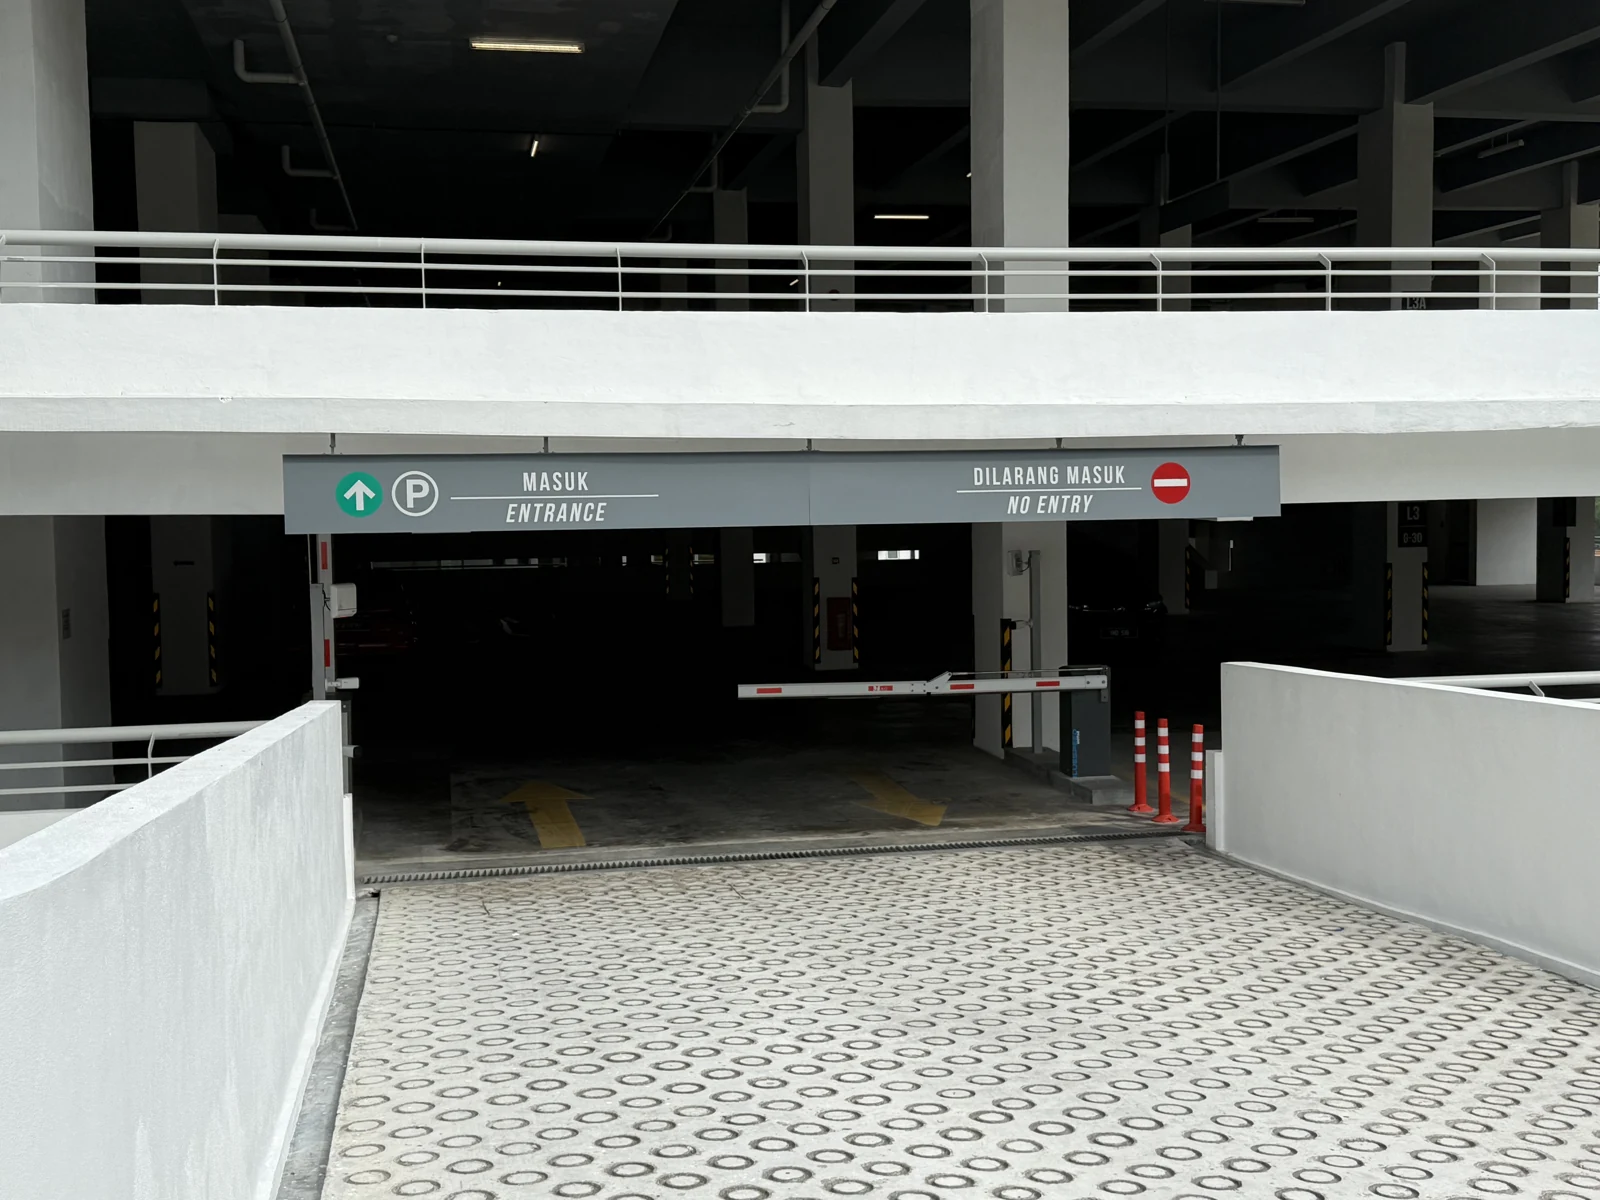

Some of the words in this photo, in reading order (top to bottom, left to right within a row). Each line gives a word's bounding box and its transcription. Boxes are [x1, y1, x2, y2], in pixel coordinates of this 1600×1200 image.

[1406, 296, 1427, 310] L3A
[522, 471, 589, 492] MASUK
[973, 466, 1059, 486] DILARANG
[1066, 465, 1126, 485] MASUK
[505, 502, 608, 524] ENTRANCE
[1007, 496, 1031, 515] NO
[1036, 494, 1094, 514] ENTRY
[1406, 505, 1421, 521] L3
